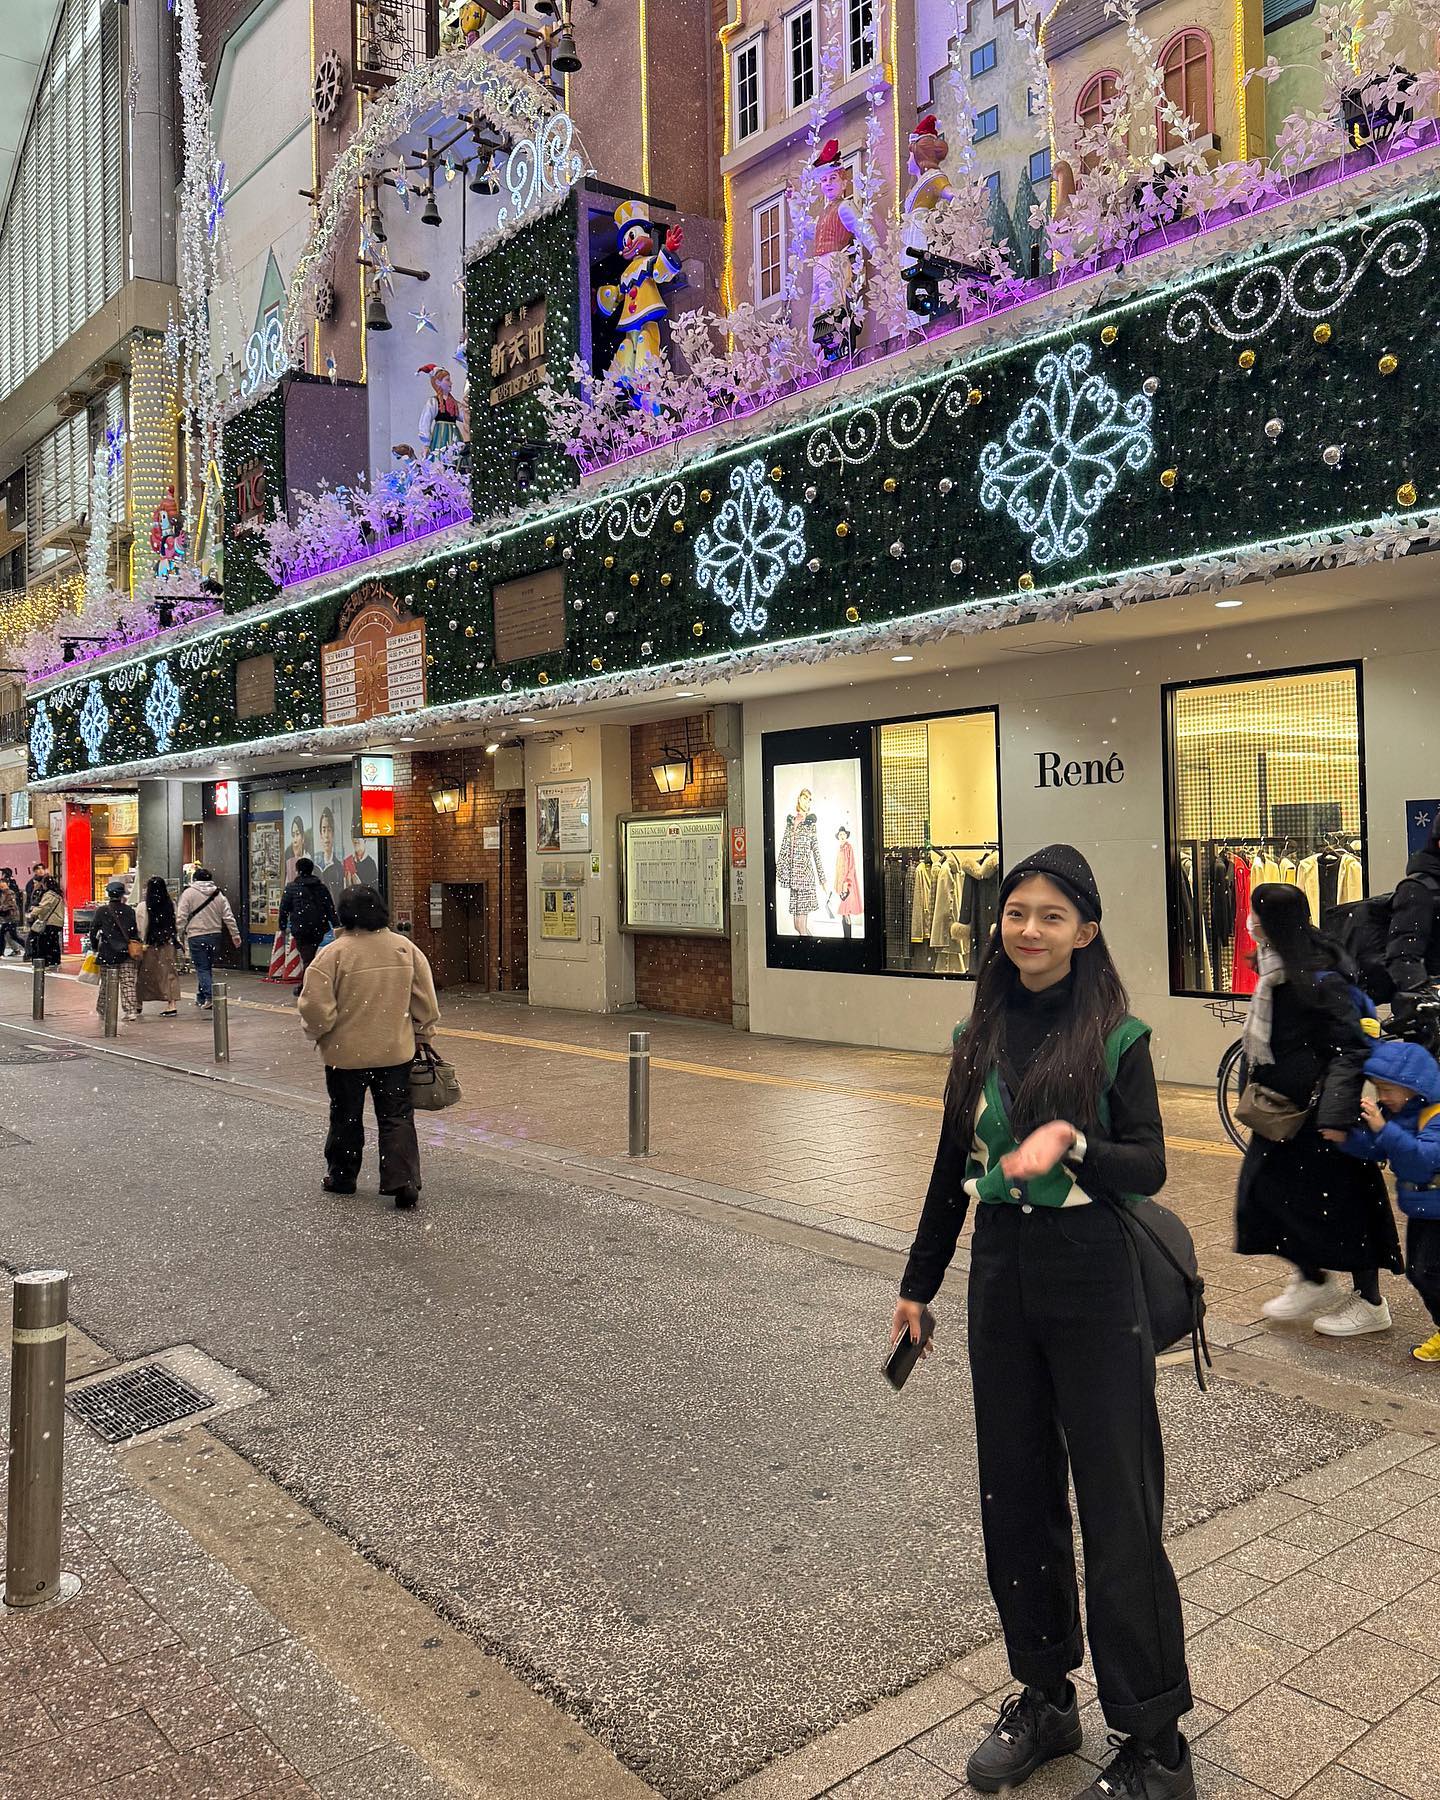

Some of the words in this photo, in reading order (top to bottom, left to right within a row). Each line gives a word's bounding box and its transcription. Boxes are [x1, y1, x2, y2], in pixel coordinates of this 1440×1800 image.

[490, 322, 545, 378] 新天町
[1033, 751, 1125, 788] René
[683, 823, 720, 833] INFORMATION
